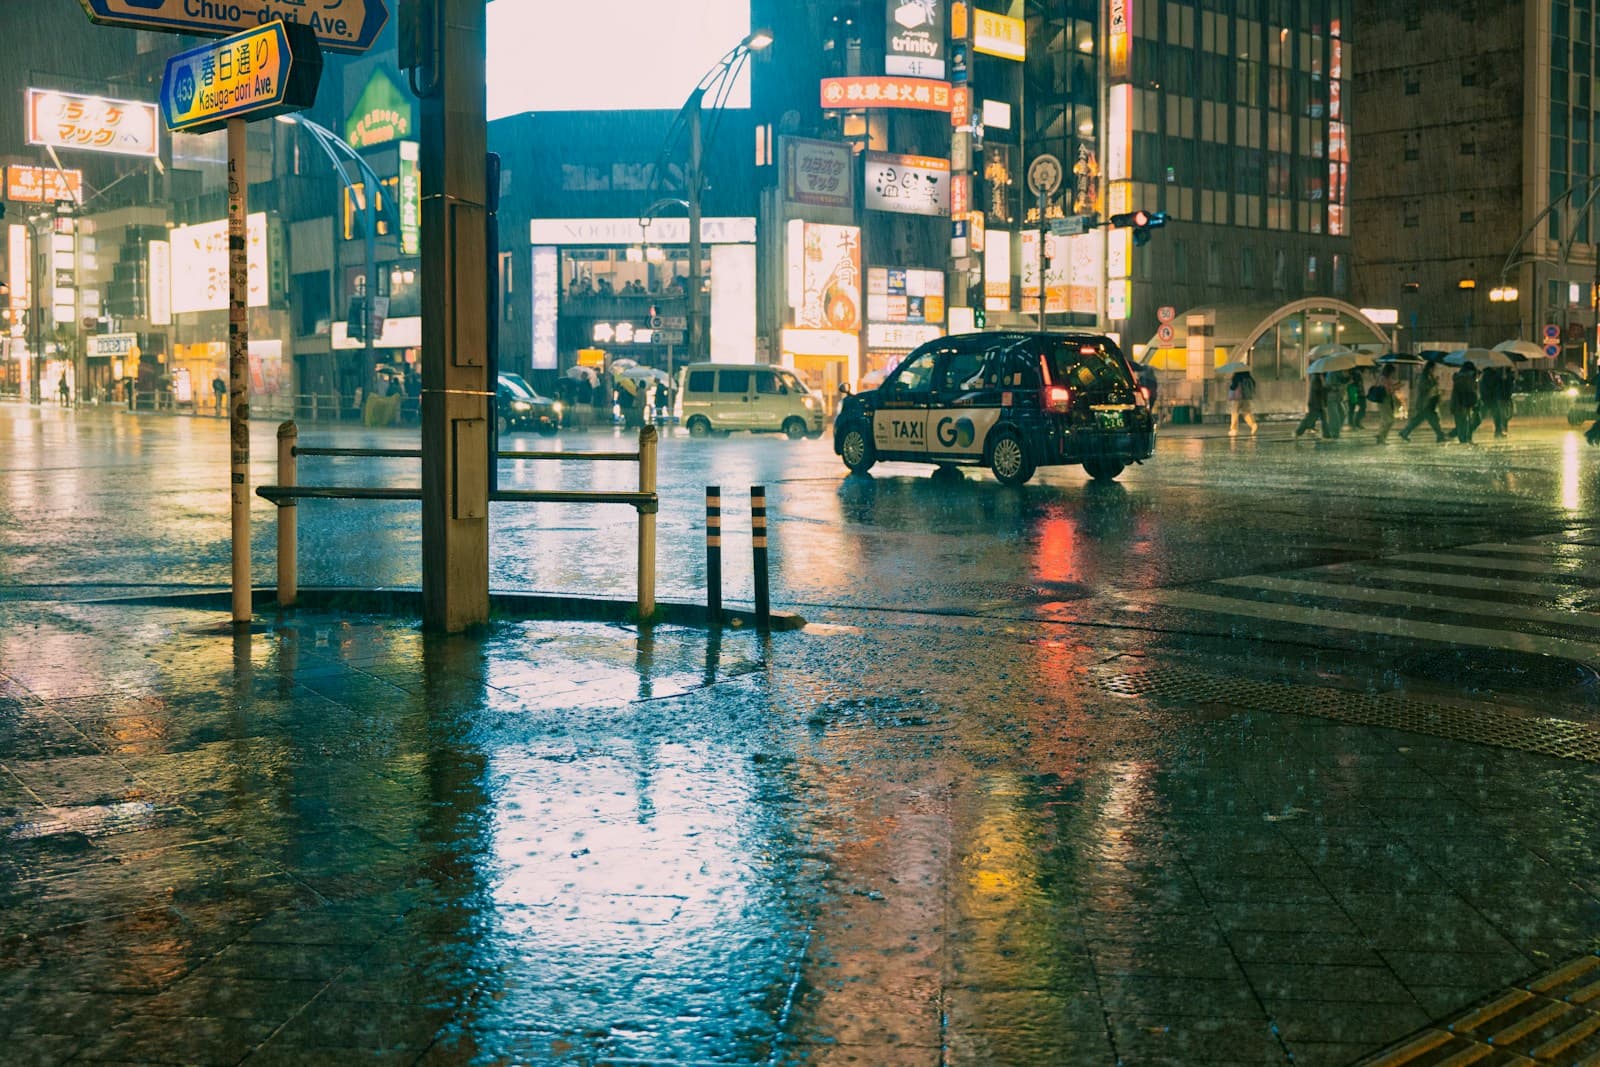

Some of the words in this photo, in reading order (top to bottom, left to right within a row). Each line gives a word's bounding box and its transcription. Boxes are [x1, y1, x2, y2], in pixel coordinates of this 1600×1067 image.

[184, 0, 298, 24] Chuo-dori
[309, 11, 353, 38] Ave.
[892, 36, 938, 56] trinity
[201, 38, 269, 87] 春日通り
[176, 78, 193, 103] 453
[199, 78, 251, 111] Kasuga-dori
[254, 74, 274, 96] Ave.
[57, 101, 124, 126] ラケ
[58, 123, 117, 146] マック
[800, 156, 846, 176] カラオケ
[807, 174, 840, 192] マック
[875, 167, 940, 205] 温野菜
[837, 229, 858, 286] 牛骨
[891, 420, 924, 440] TAXI
[936, 416, 976, 449] GO
